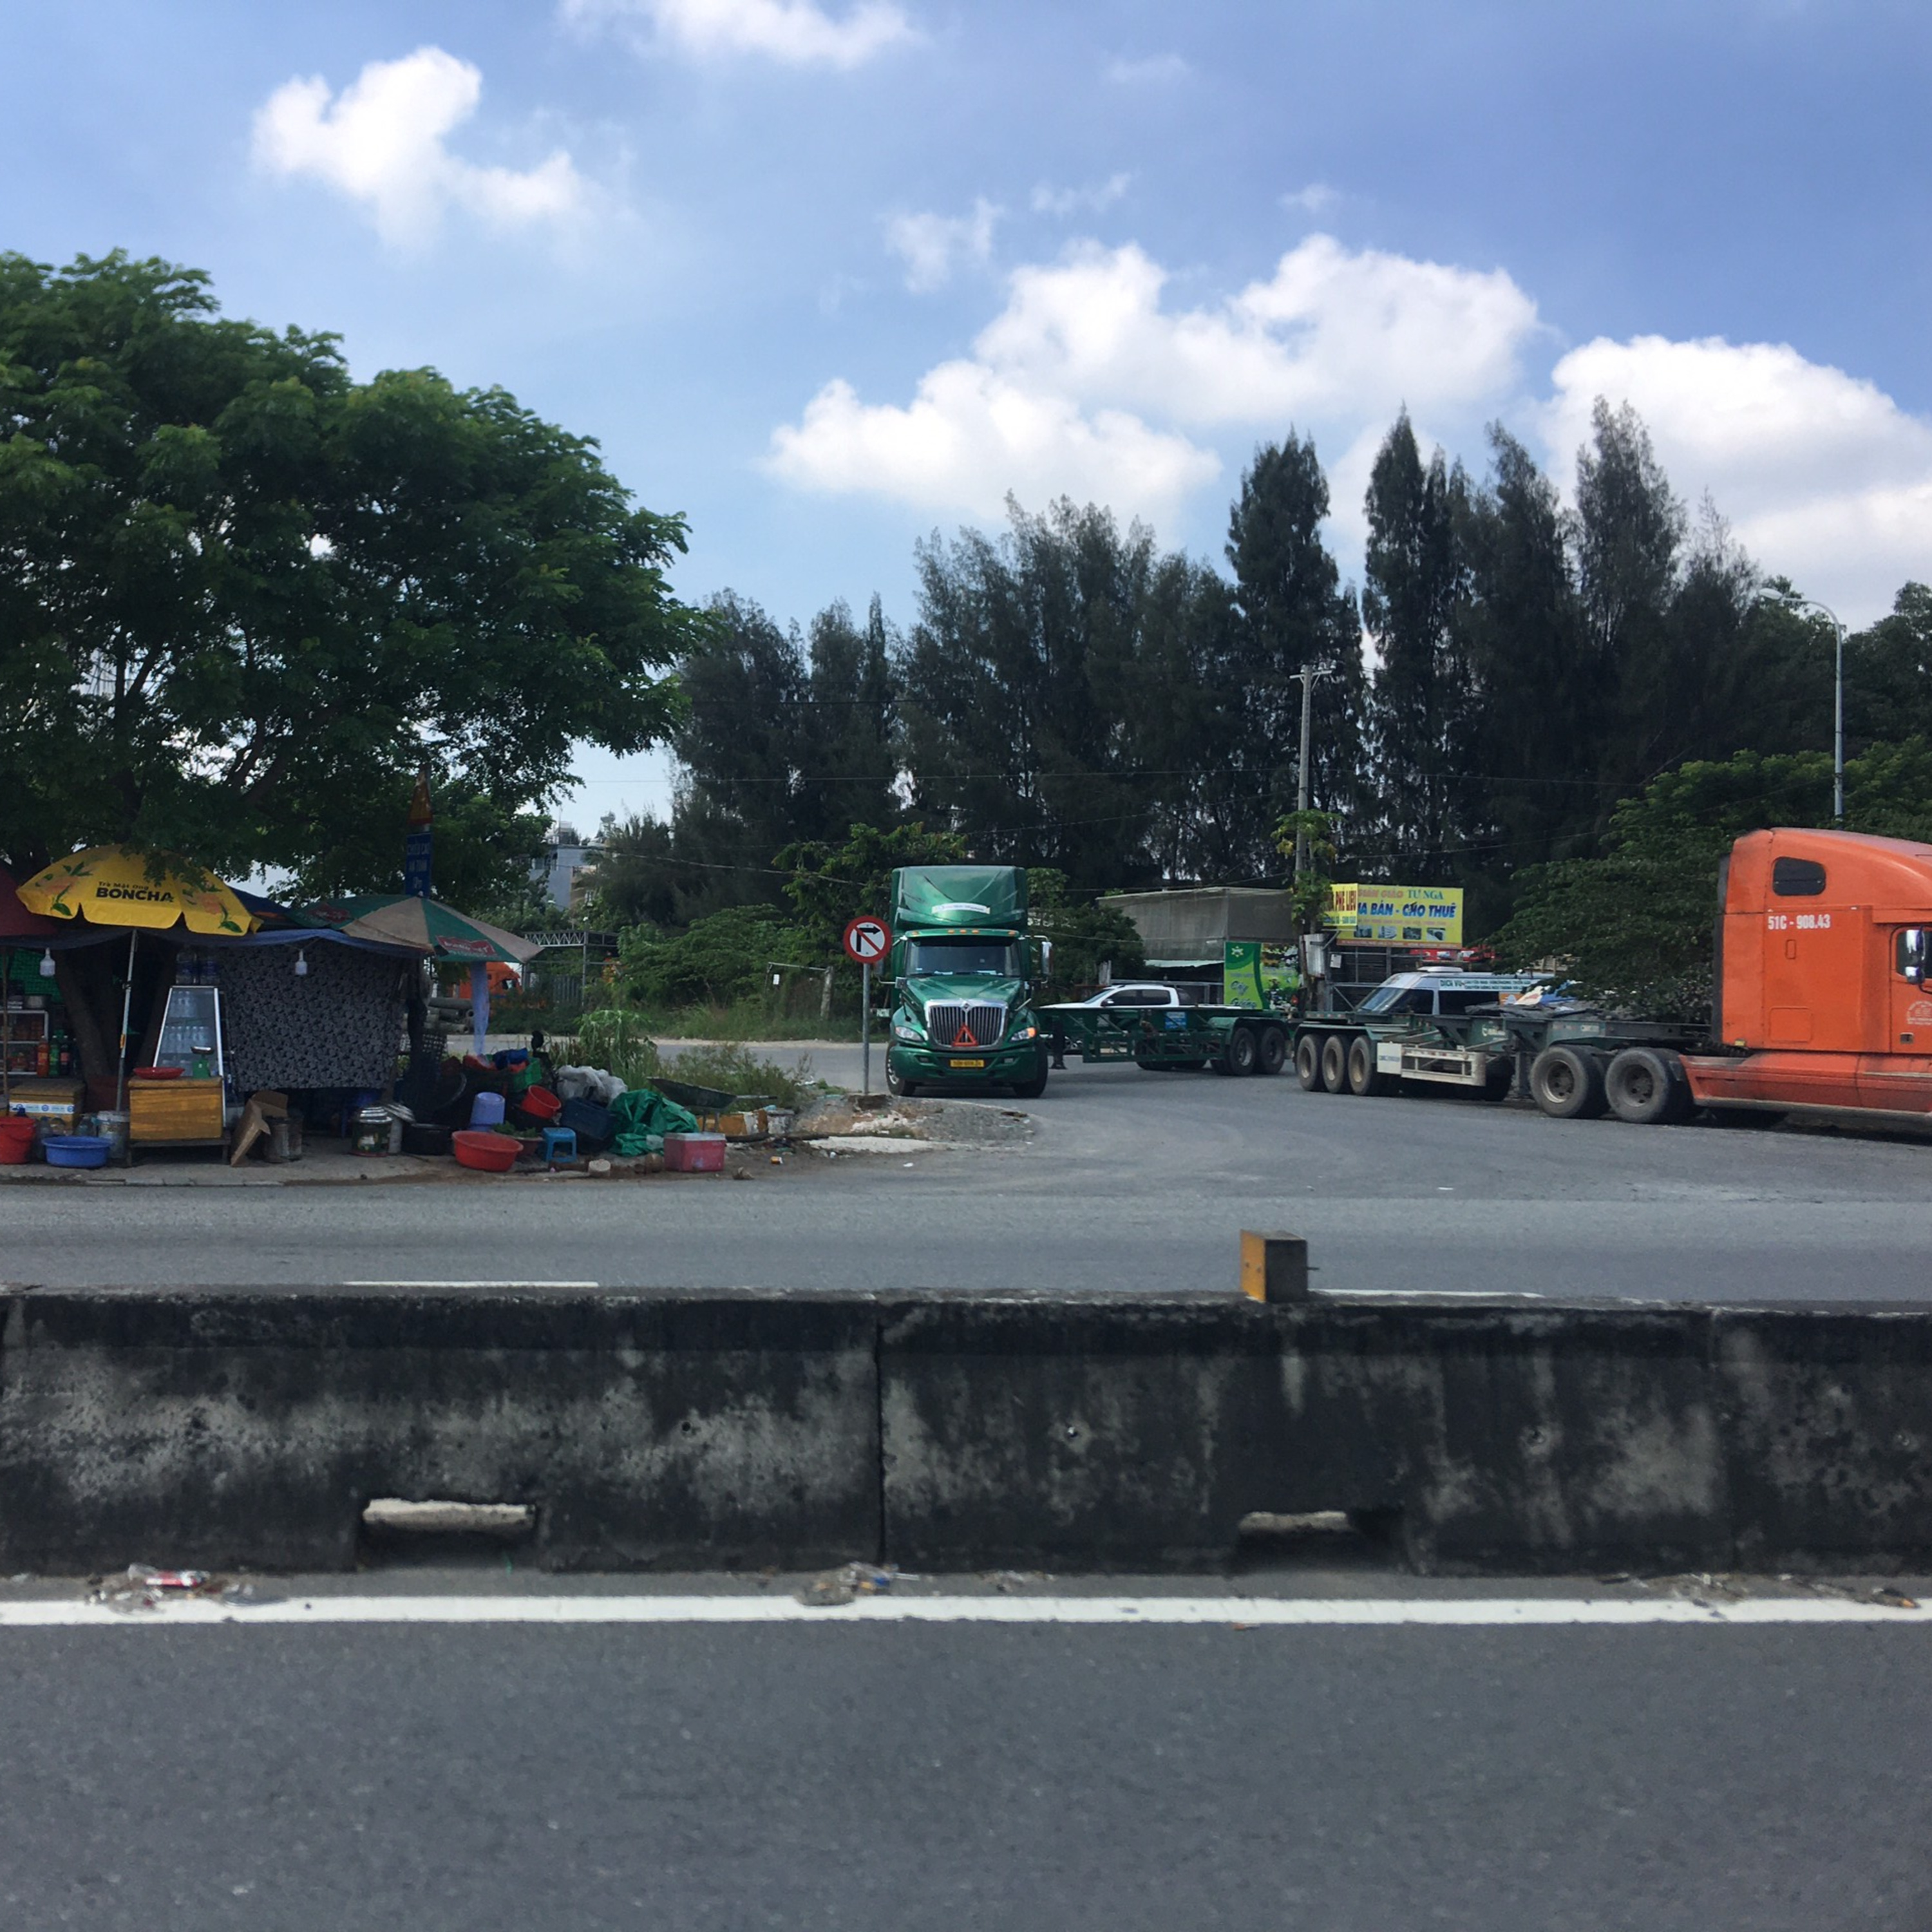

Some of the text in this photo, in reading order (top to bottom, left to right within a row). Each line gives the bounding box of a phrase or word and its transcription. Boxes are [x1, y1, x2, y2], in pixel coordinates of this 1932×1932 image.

[96, 887, 174, 902] BONCHA
[1423, 890, 1444, 900] NGA
[1370, 900, 1394, 916] BÁN
[1402, 903, 1426, 918] CHO
[1428, 903, 1457, 918] THUÊ
[1768, 915, 1787, 929] 51C
[1796, 914, 1831, 929] 908.43
